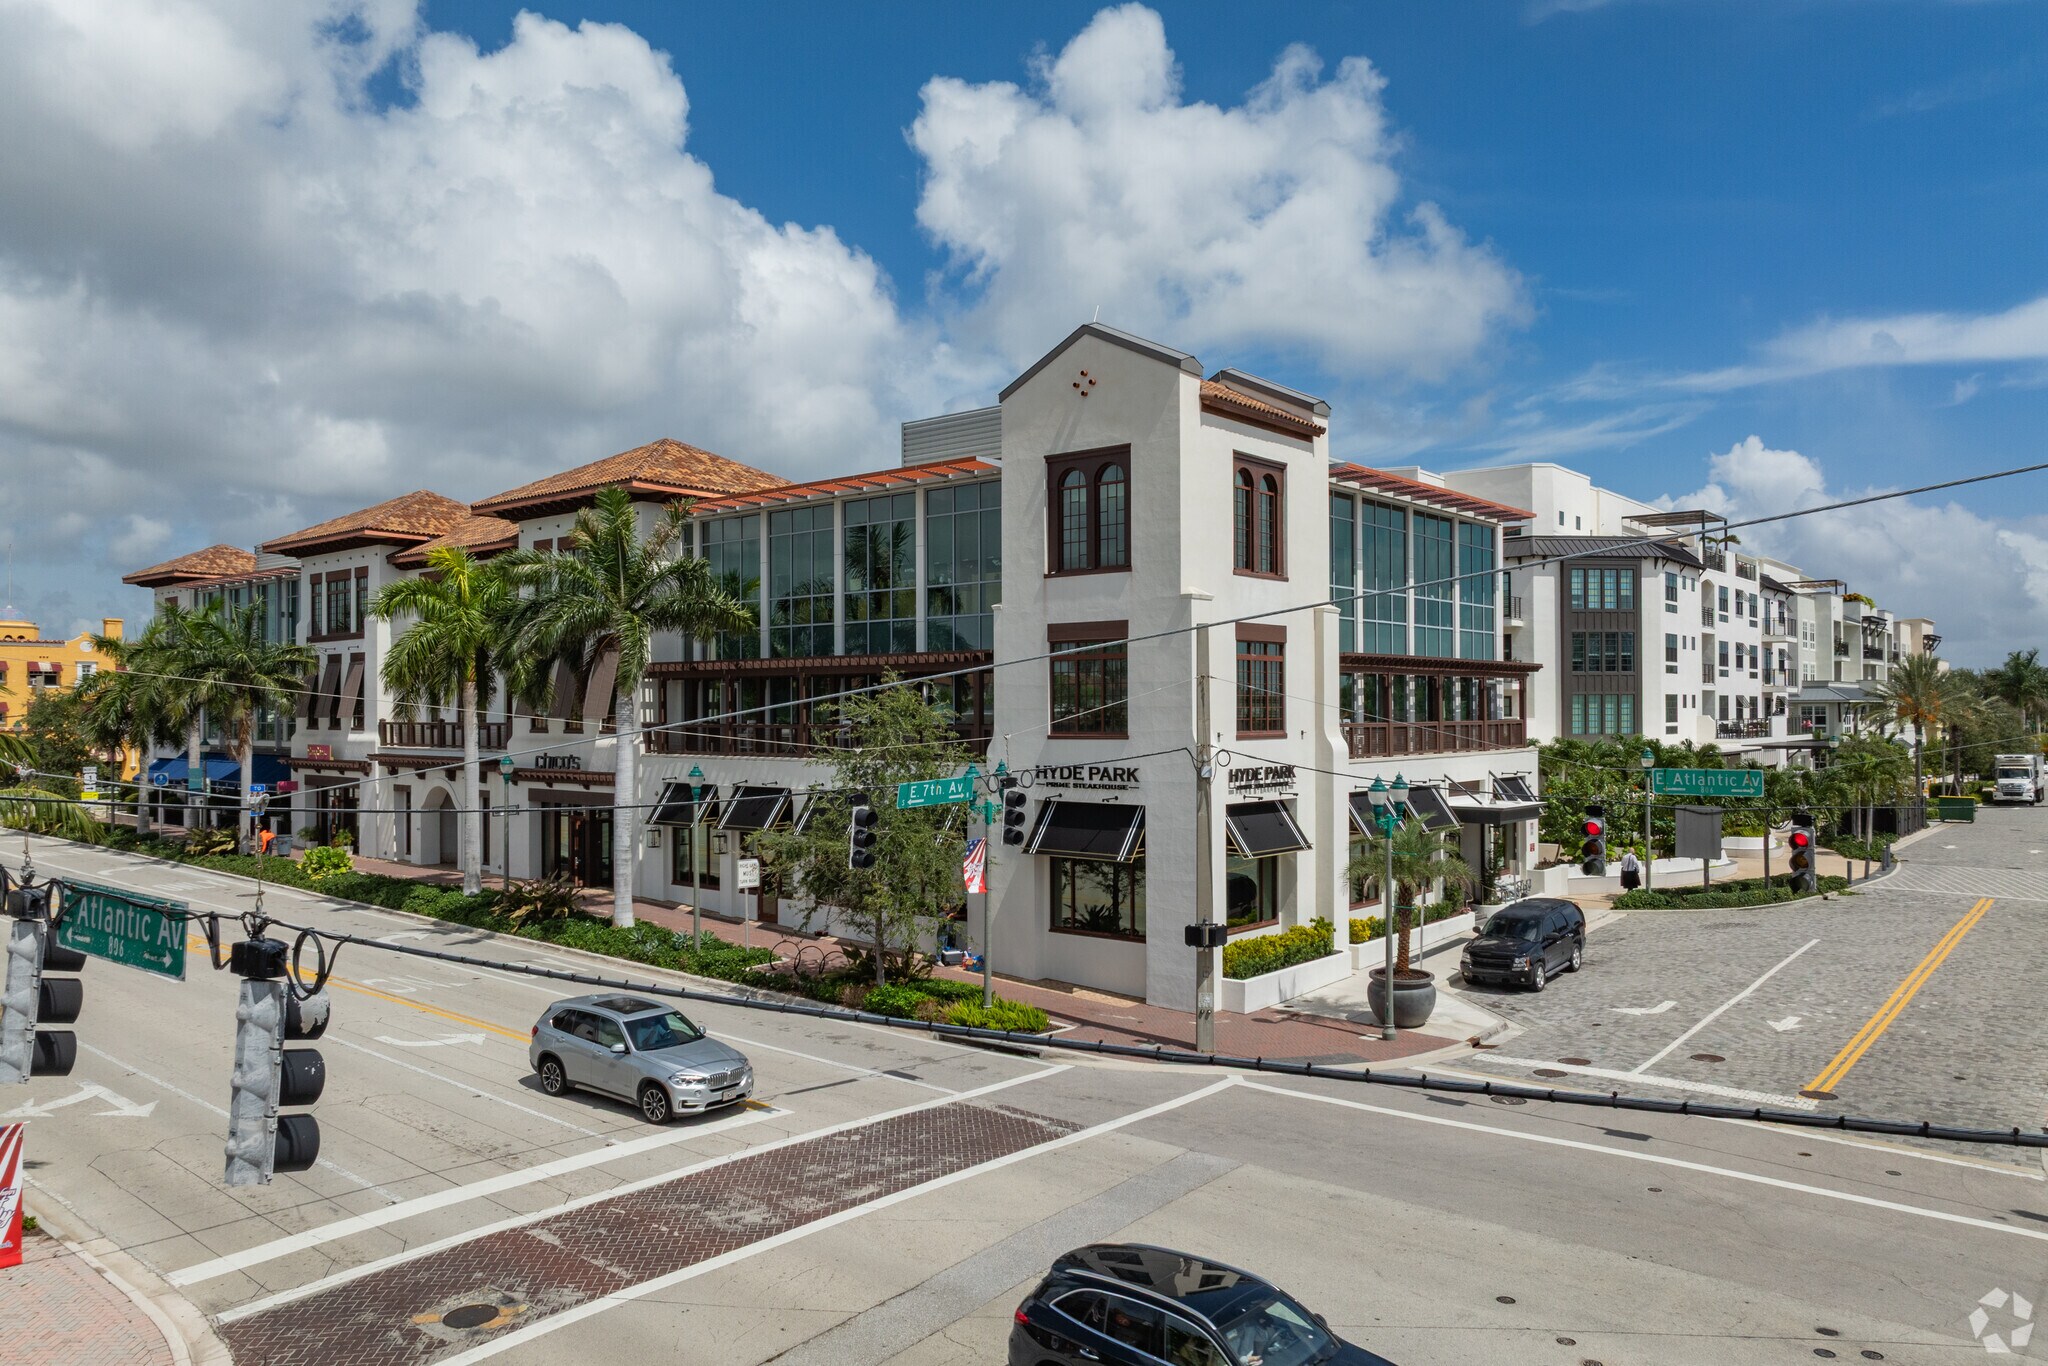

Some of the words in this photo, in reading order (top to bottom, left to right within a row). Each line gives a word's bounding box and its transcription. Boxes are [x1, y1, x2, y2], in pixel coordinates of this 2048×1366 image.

[1035, 765, 1085, 781] HYDE
[1088, 766, 1139, 783] PARK
[1229, 766, 1263, 782] HYDE
[1264, 765, 1296, 780] PARK
[1673, 773, 1737, 786] Atlantic
[1072, 783, 1129, 791] STEAKHOUSE
[77, 896, 151, 942] Atlantic
